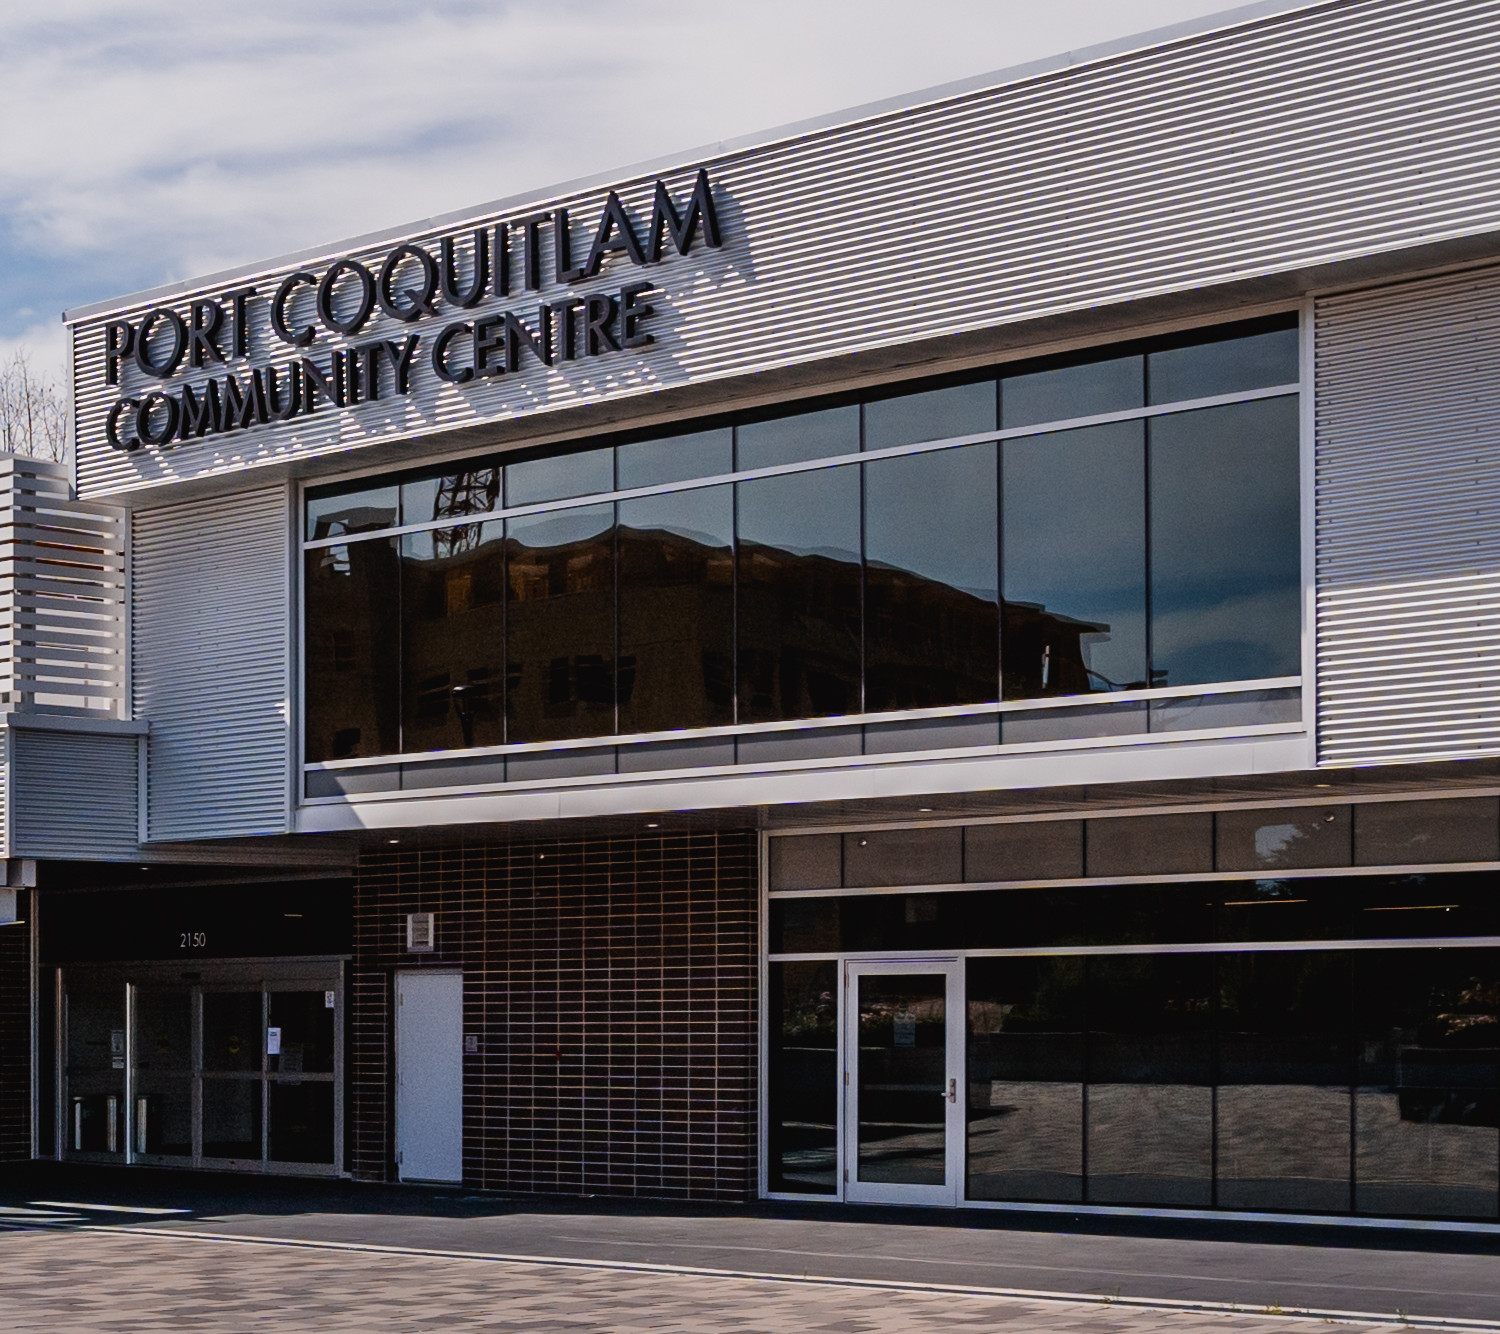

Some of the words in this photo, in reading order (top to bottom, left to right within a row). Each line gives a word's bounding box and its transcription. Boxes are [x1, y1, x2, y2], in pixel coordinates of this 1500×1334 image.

[105, 287, 257, 385] PORT
[271, 168, 722, 347] COQUITLAM
[106, 334, 420, 452] COMMUNITY
[432, 281, 655, 383] CENTRE
[180, 932, 206, 948] 2150
